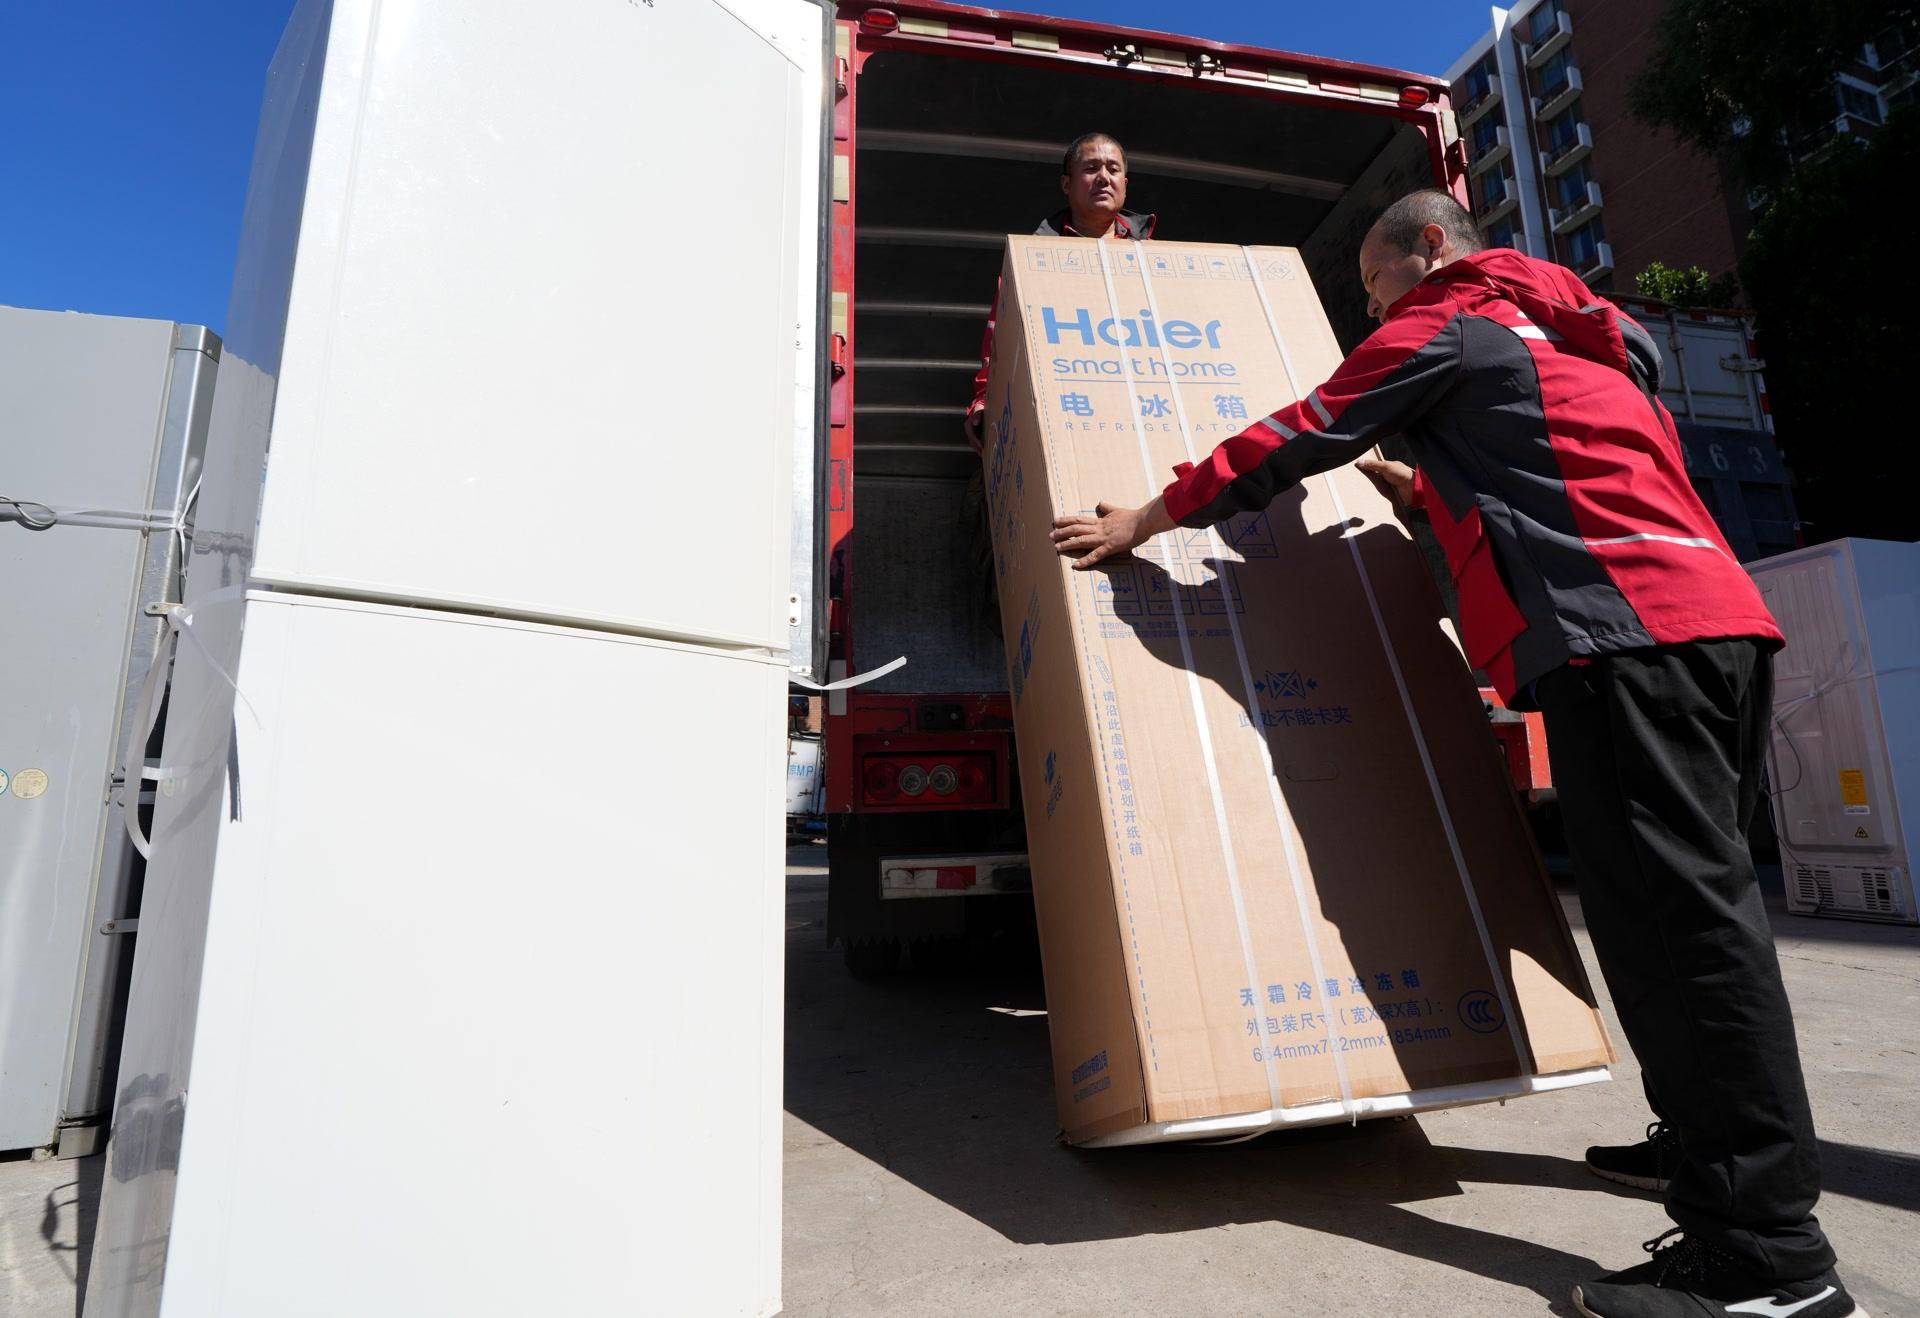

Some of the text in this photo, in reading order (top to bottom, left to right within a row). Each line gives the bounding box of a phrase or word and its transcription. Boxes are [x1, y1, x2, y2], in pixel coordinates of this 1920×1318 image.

[1041, 306, 1222, 349] Haier
[1052, 357, 1236, 377] smat home
[1059, 392, 1248, 419] 电冰箱
[1065, 422, 1250, 432] REFRIGEATO
